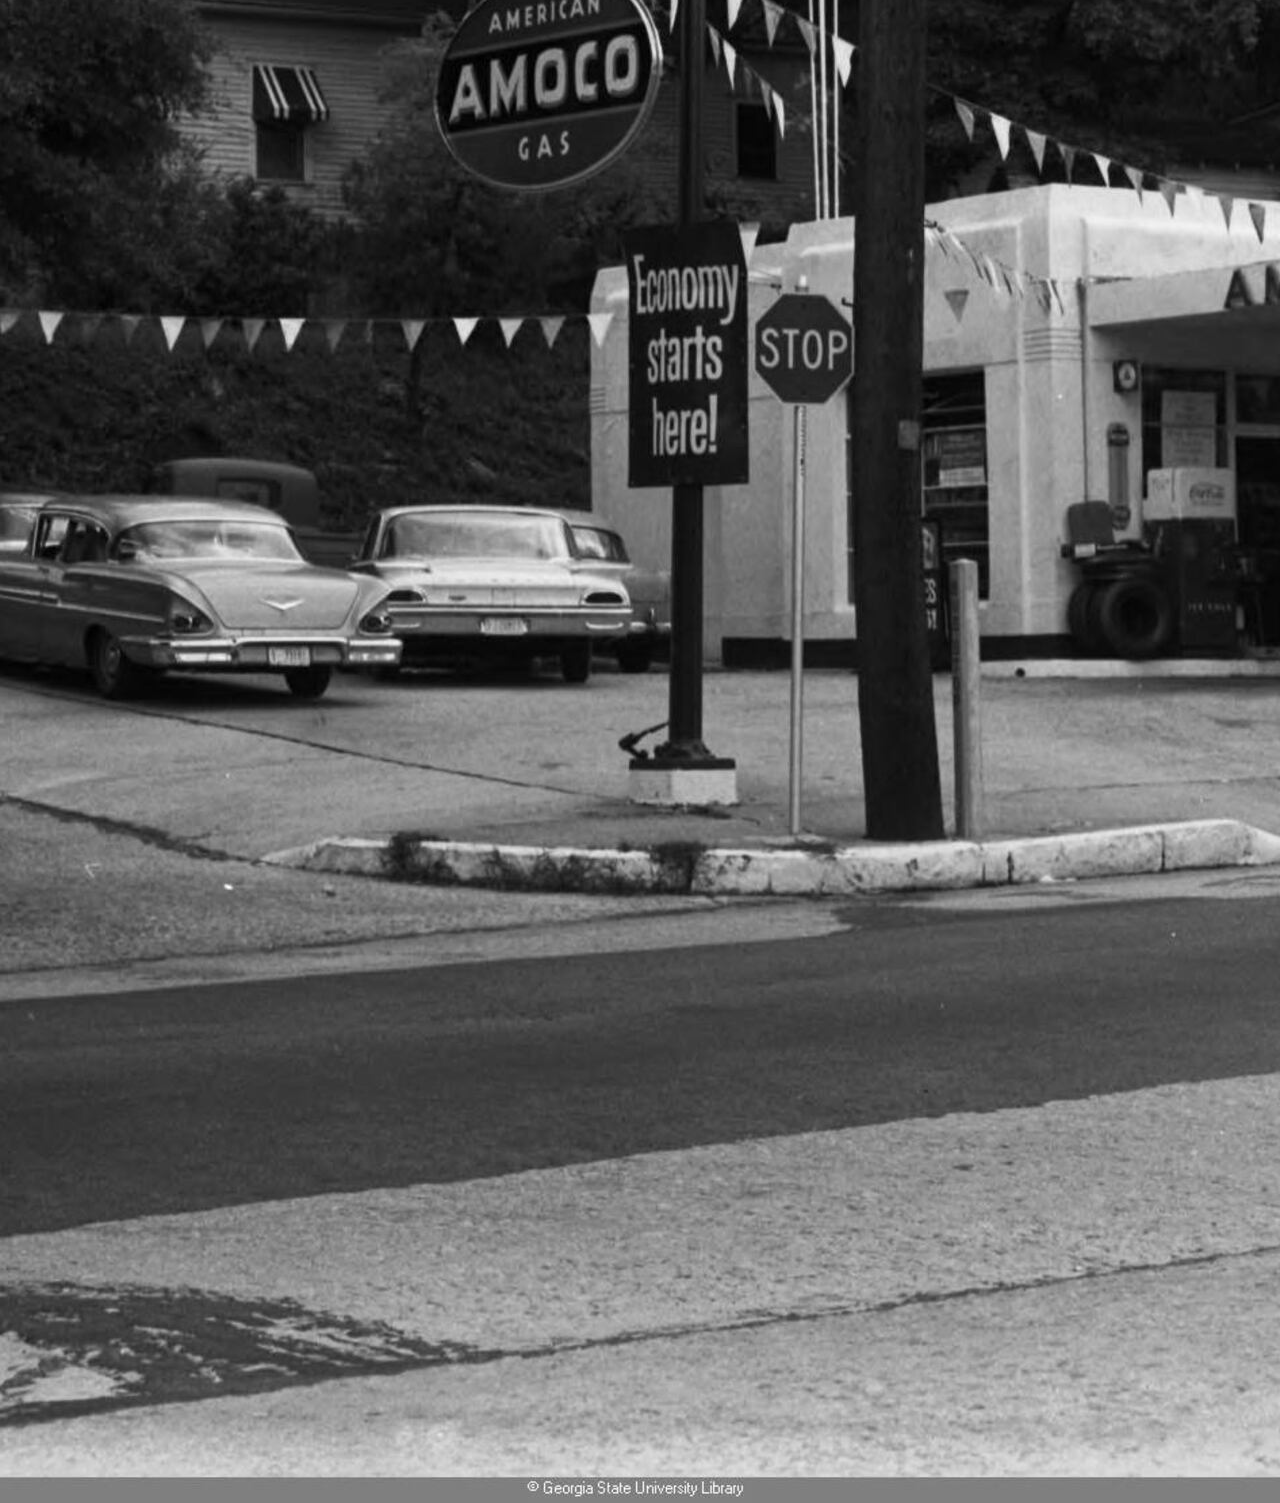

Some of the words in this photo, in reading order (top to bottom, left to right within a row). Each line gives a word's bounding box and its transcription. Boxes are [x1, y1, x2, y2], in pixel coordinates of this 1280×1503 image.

[448, 33, 639, 125] AMOCO
[518, 130, 570, 161] GAS
[633, 254, 739, 326] Economy
[647, 326, 724, 384] starts
[759, 327, 849, 371] STOP
[652, 394, 718, 456] here!
